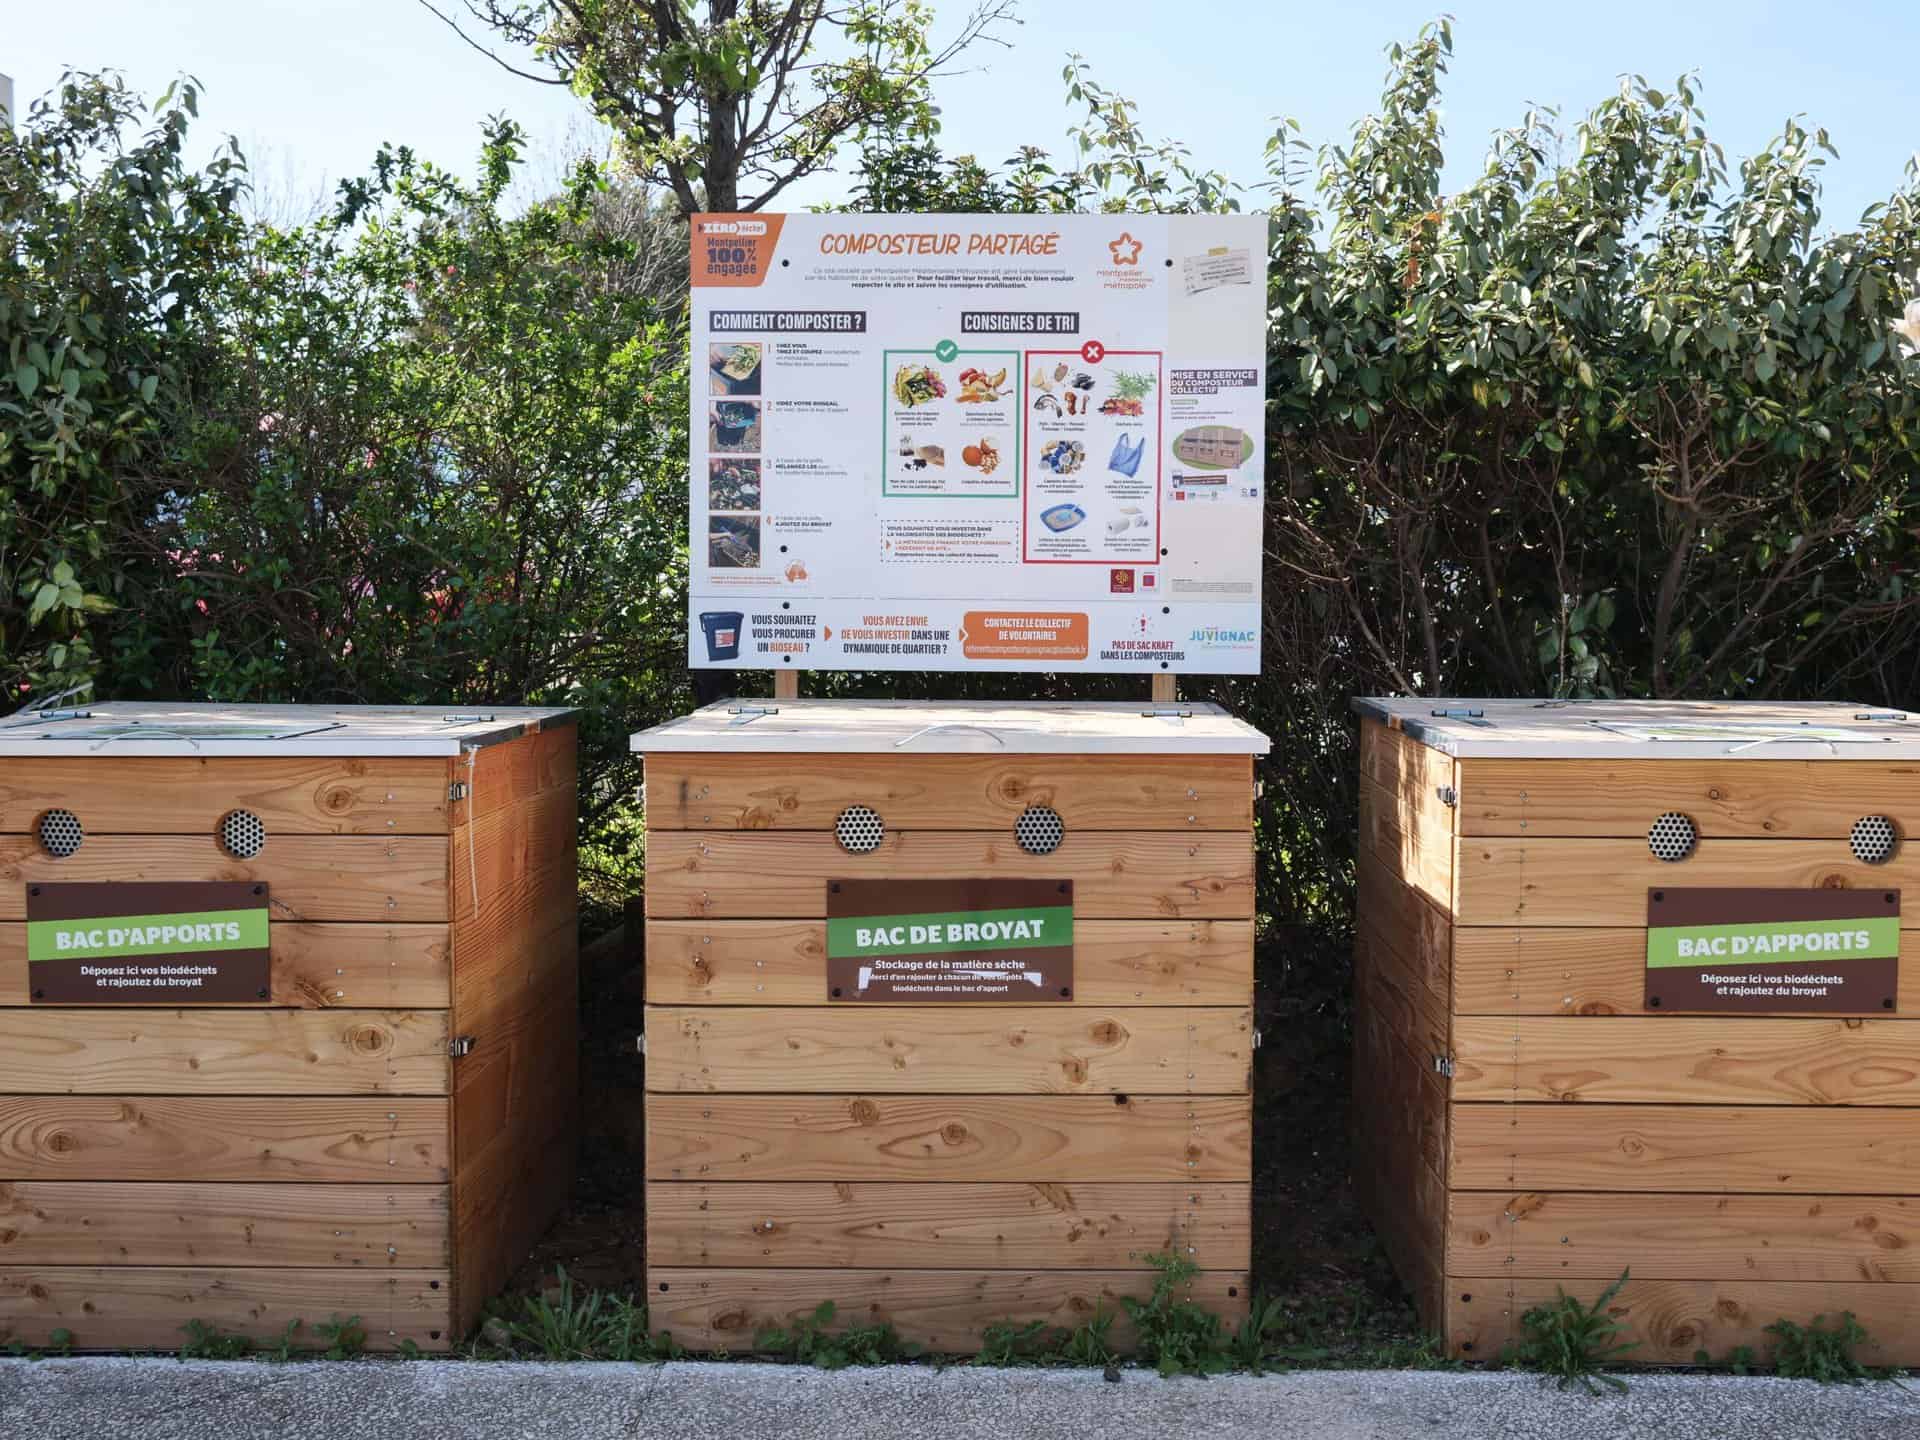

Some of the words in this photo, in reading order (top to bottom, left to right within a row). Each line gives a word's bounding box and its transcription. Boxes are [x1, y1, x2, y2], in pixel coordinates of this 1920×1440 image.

[707, 238, 757, 248] Montpellier
[820, 233, 961, 255] COMPOSTEUR
[967, 232, 1060, 255] PARTAGÉ
[707, 247, 757, 263] 100%
[713, 313, 776, 330] COMMENT
[777, 313, 852, 330] COMPOSTER
[855, 314, 862, 330] ?
[964, 315, 1034, 331] CONSIGNES
[1036, 315, 1052, 331] DE
[1054, 315, 1075, 331] TRI
[1171, 371, 1194, 379] MISE
[1197, 371, 1211, 379] EN
[1212, 371, 1255, 379] SERVICE
[1171, 386, 1217, 394] COLLECTIF
[752, 615, 773, 625] VOUS
[773, 615, 817, 625] SOUHAITEZ
[863, 615, 885, 626] VOUS
[885, 616, 904, 626] AVEZ
[905, 616, 928, 626] ENVIE
[984, 617, 1024, 628] CONTACTEZ
[1025, 618, 1034, 628] LE
[1034, 618, 1072, 628] COLLECTIF
[752, 628, 773, 639] VOUS
[774, 628, 816, 639] PROCURER
[841, 629, 851, 640] DE
[853, 629, 874, 640] VOUS
[874, 629, 911, 640] INVESTIR
[911, 630, 933, 640] DANS
[934, 630, 950, 640] UNE
[998, 630, 1008, 640] DE
[1009, 630, 1056, 641] VOLONTAIRES
[1190, 630, 1255, 641] JUVIGNAC
[757, 642, 769, 653] UN
[769, 642, 804, 653] BIOSEAU
[805, 643, 810, 653] ?
[843, 643, 890, 654] DYNAMIQUE
[891, 644, 902, 654] DE
[902, 644, 942, 654] QUARTIER
[943, 644, 947, 654] ?
[1112, 640, 1126, 650] PAS
[1127, 640, 1136, 650] DE
[1137, 641, 1151, 650] SAC
[1151, 641, 1174, 650] KRAFT
[1100, 650, 1120, 660] DANS
[1121, 651, 1133, 660] LES
[1134, 651, 1185, 661] COMPOSTEURS
[56, 930, 104, 950] BAC
[108, 921, 241, 948] D'APPORTS
[856, 927, 905, 947] BAC
[910, 924, 942, 945] DE
[947, 919, 1044, 943] BROYAT
[1678, 937, 1727, 957] BAC
[1732, 930, 1870, 955] D'APPORTS
[81, 965, 125, 977] Déposez
[126, 965, 138, 975] ici
[140, 967, 159, 975] vos
[160, 965, 217, 975] biodéchets
[875, 960, 923, 971] Stockage
[925, 960, 939, 969] de
[941, 960, 951, 969] la
[952, 960, 993, 969] matière
[994, 960, 1025, 969] sèche
[96, 978, 107, 986] et
[109, 977, 151, 988] rajoutez
[153, 977, 167, 986] du
[169, 977, 202, 988] broyat
[906, 973, 936, 982] rajouter
[1701, 973, 1747, 985] Déposez
[1749, 974, 1762, 984] ici
[1763, 975, 1783, 984] vos
[1784, 974, 1843, 985] biodéchets
[892, 984, 933, 992] biodéchets
[976, 985, 1008, 993] d'apport
[1716, 987, 1728, 995] et
[1729, 986, 1773, 997] rajoutez
[1775, 986, 1790, 996] du
[1792, 986, 1827, 997] broyat
